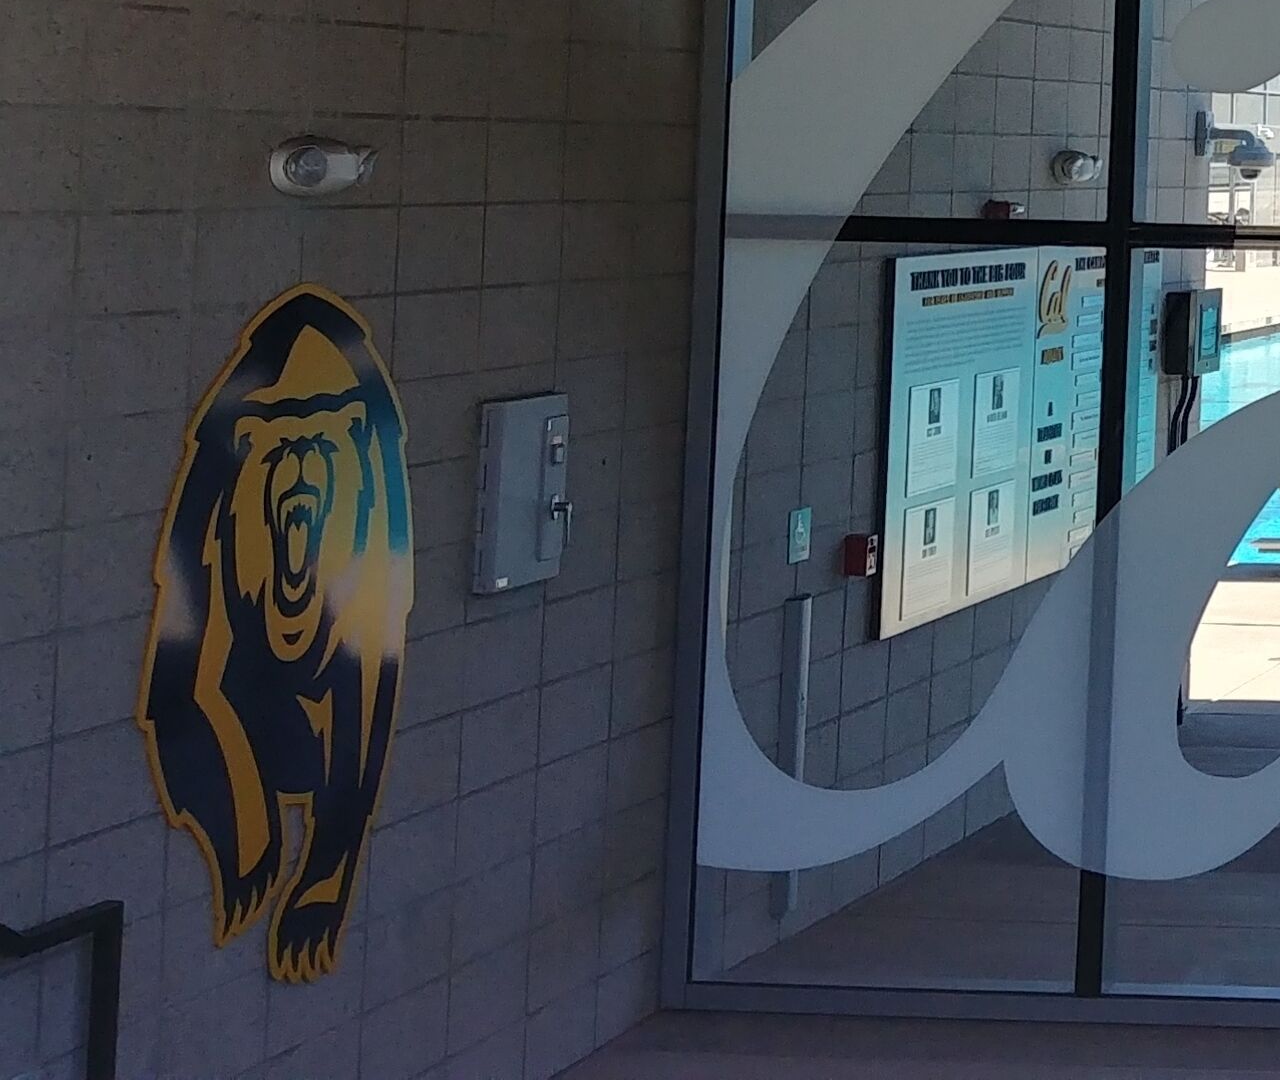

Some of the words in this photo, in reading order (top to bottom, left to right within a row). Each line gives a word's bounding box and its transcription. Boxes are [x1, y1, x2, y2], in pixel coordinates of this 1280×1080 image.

[910, 270, 939, 292] THANK
[940, 267, 958, 288] YOU
[959, 266, 971, 286] TO
[971, 265, 988, 284] THE
[988, 264, 1004, 283] BIG
[1036, 259, 1073, 340] Cal
